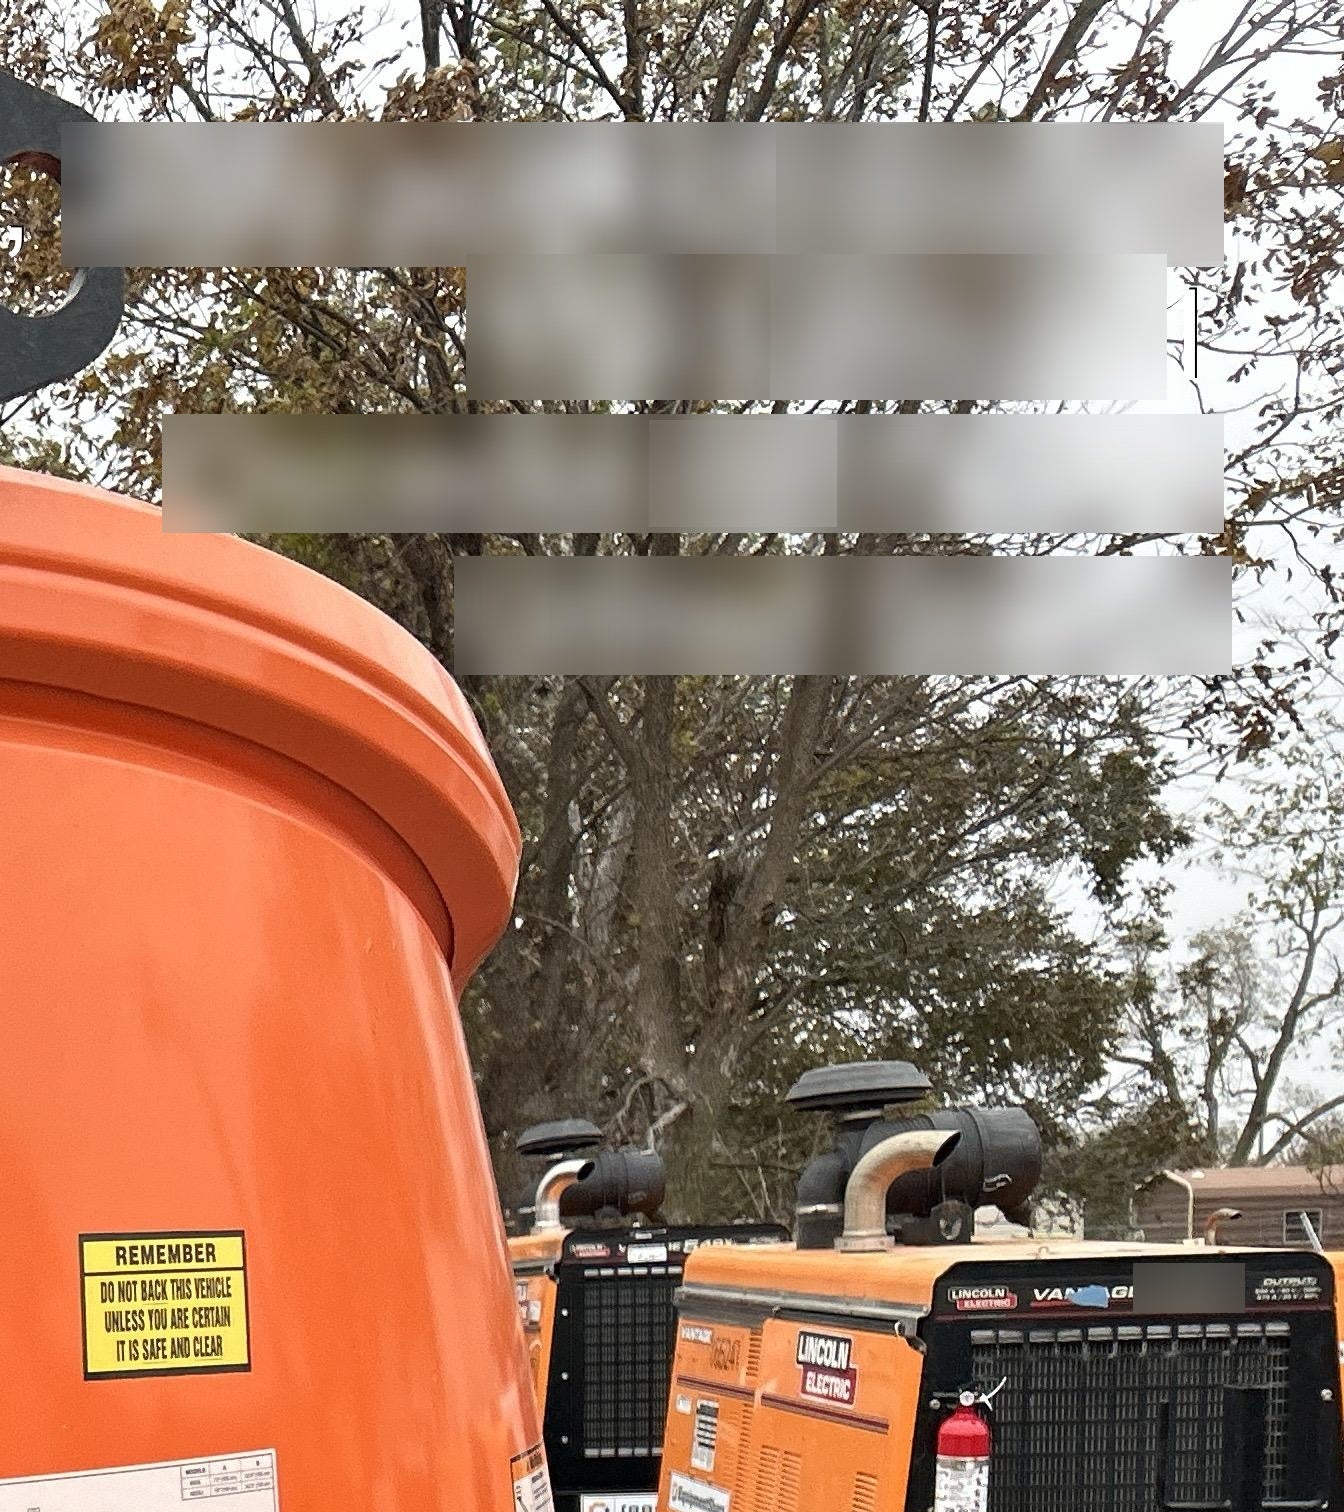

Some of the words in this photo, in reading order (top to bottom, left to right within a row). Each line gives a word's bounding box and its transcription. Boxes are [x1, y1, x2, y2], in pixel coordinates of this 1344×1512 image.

[115, 1243, 217, 1266] REMEMBER
[100, 1281, 115, 1303] DO
[118, 1280, 138, 1303] NOT
[141, 1279, 168, 1301] BACK
[170, 1278, 192, 1300] THIS
[194, 1276, 232, 1299] VEHICLE
[951, 1288, 1006, 1300] LINCOLN
[104, 1309, 145, 1333] UNLESS
[148, 1308, 168, 1330] YOU
[170, 1307, 189, 1329] ARE
[192, 1306, 231, 1329] CERTAIN
[116, 1340, 126, 1362] IT
[129, 1339, 139, 1361] IS
[142, 1338, 168, 1361] SAFE
[170, 1336, 191, 1359] AND
[193, 1335, 223, 1357] CLEAR
[798, 1334, 850, 1370] LINCOLN
[805, 1371, 851, 1401] ELECTRIC
